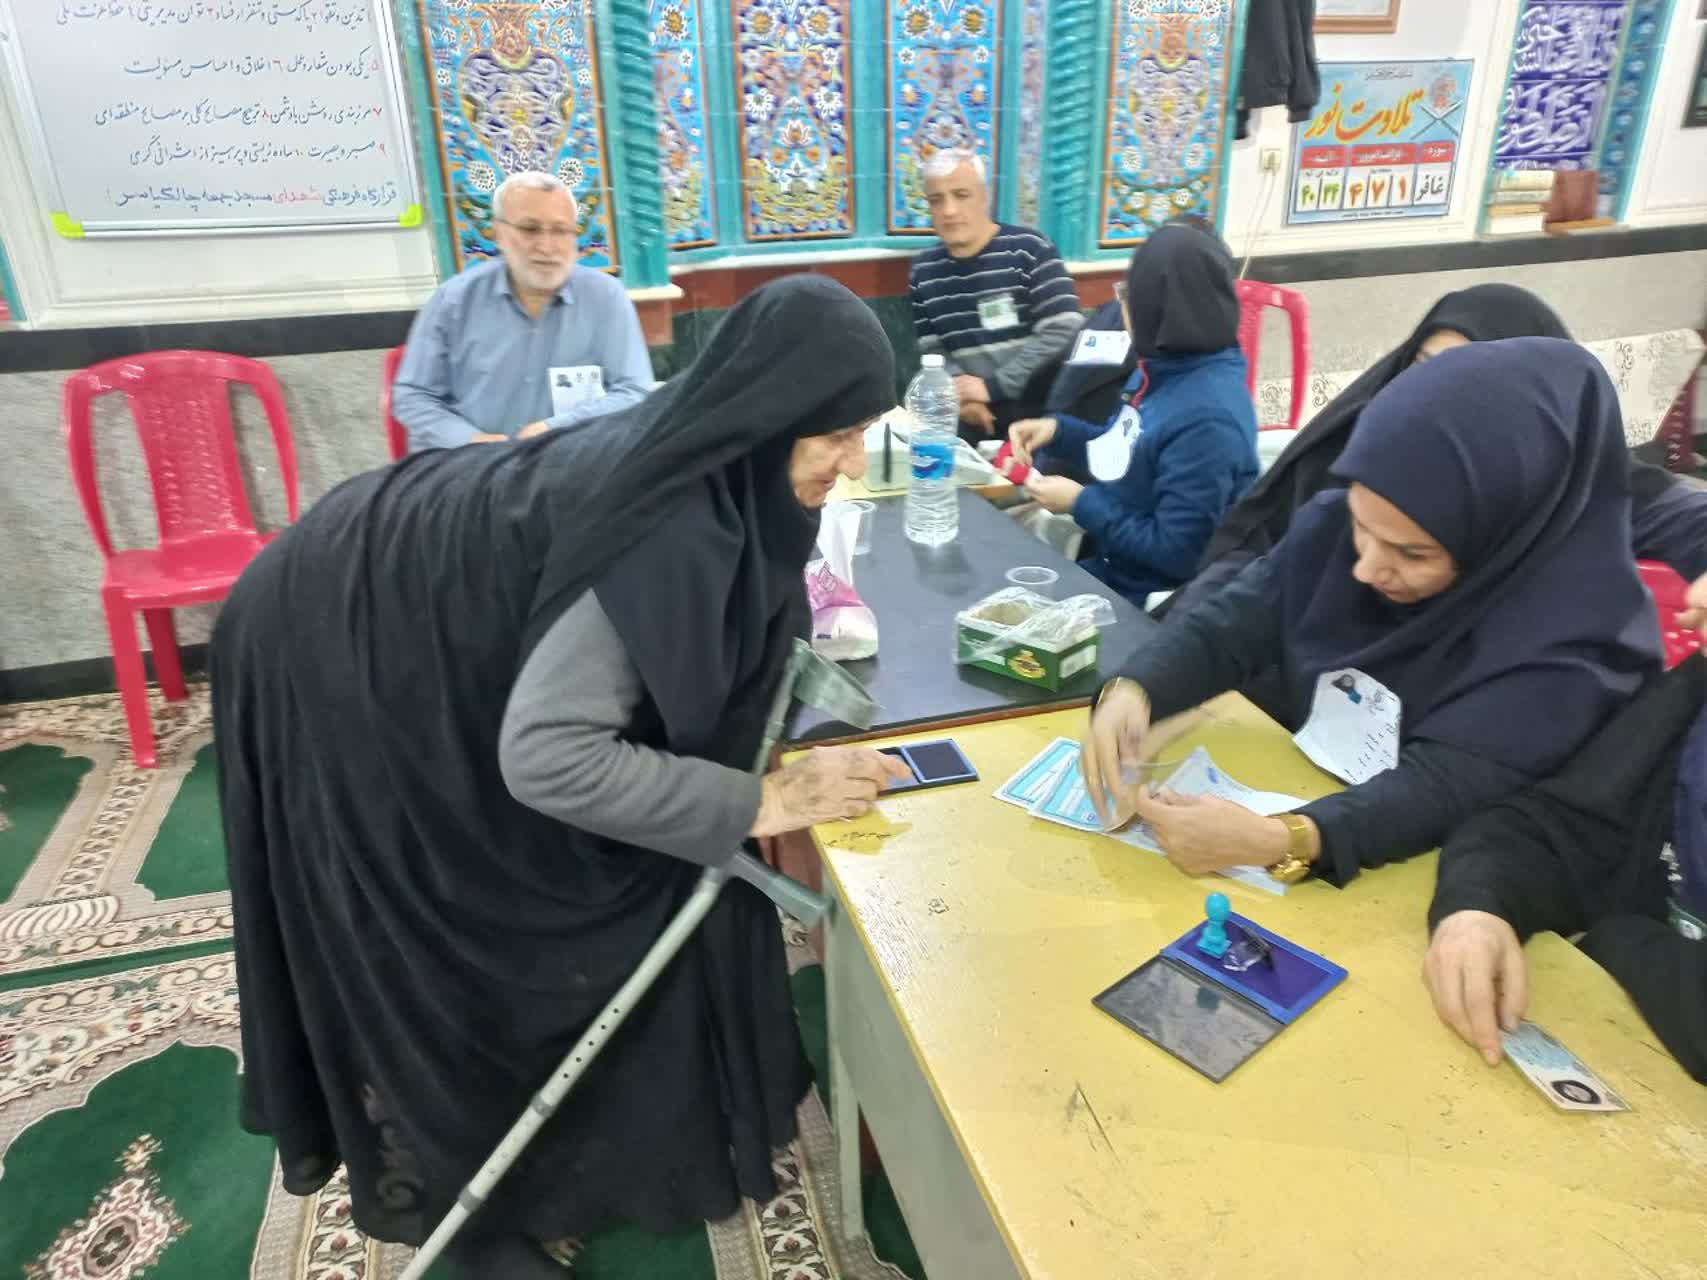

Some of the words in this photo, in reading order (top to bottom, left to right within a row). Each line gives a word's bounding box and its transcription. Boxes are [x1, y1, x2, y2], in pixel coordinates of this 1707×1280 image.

[1303, 80, 1344, 140] نور
[1335, 87, 1425, 142] تلاوت
[1416, 173, 1445, 201] غافر
